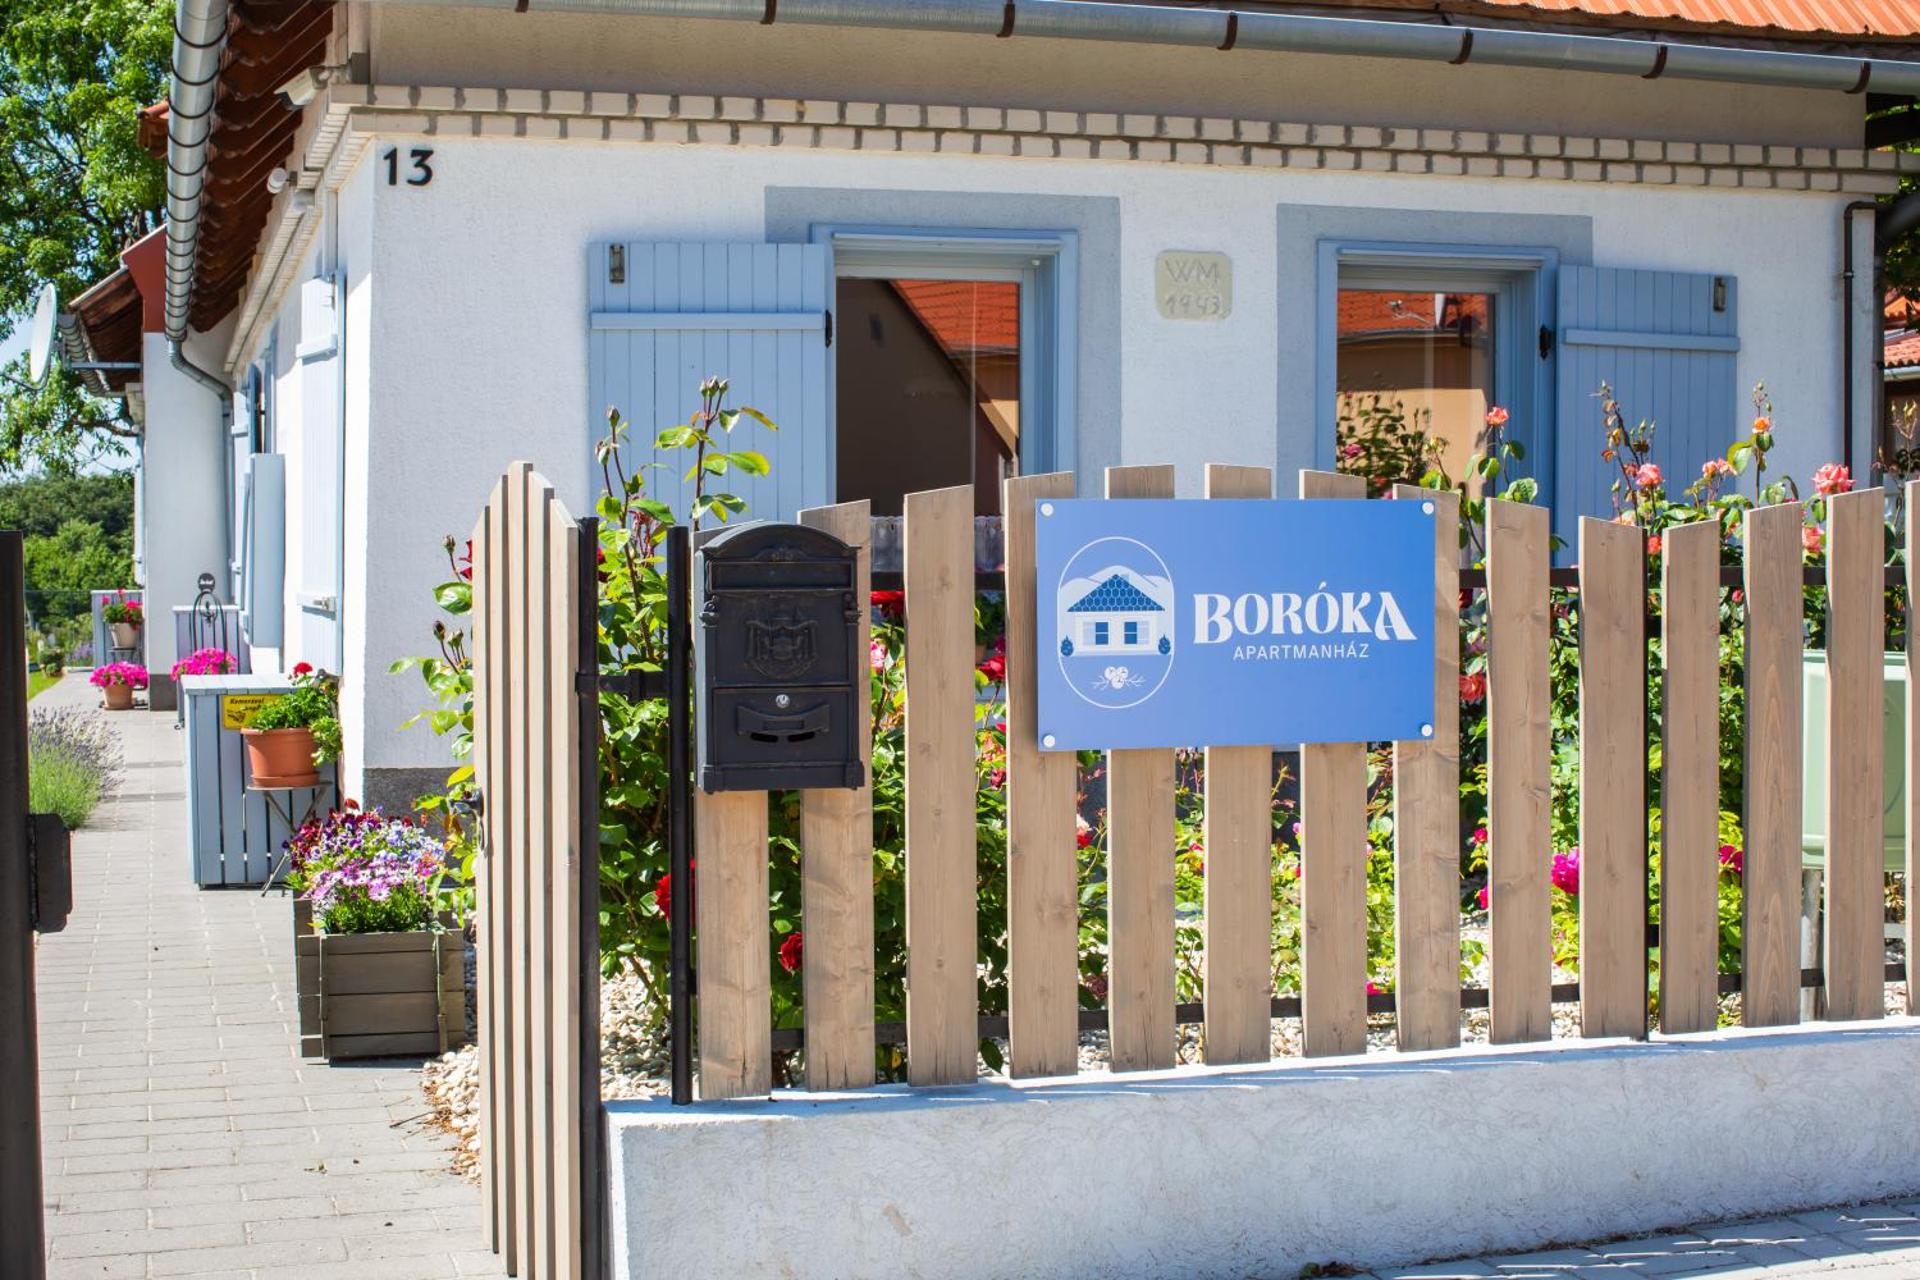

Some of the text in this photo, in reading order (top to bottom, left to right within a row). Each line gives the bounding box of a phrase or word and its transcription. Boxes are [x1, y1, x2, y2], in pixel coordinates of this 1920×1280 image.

[383, 147, 434, 186] 13
[1164, 258, 1218, 283] WM
[1165, 294, 1220, 315] 1943
[1193, 581, 1418, 644] BORÓKA
[1233, 641, 1369, 661] APARTMANHÁZ
